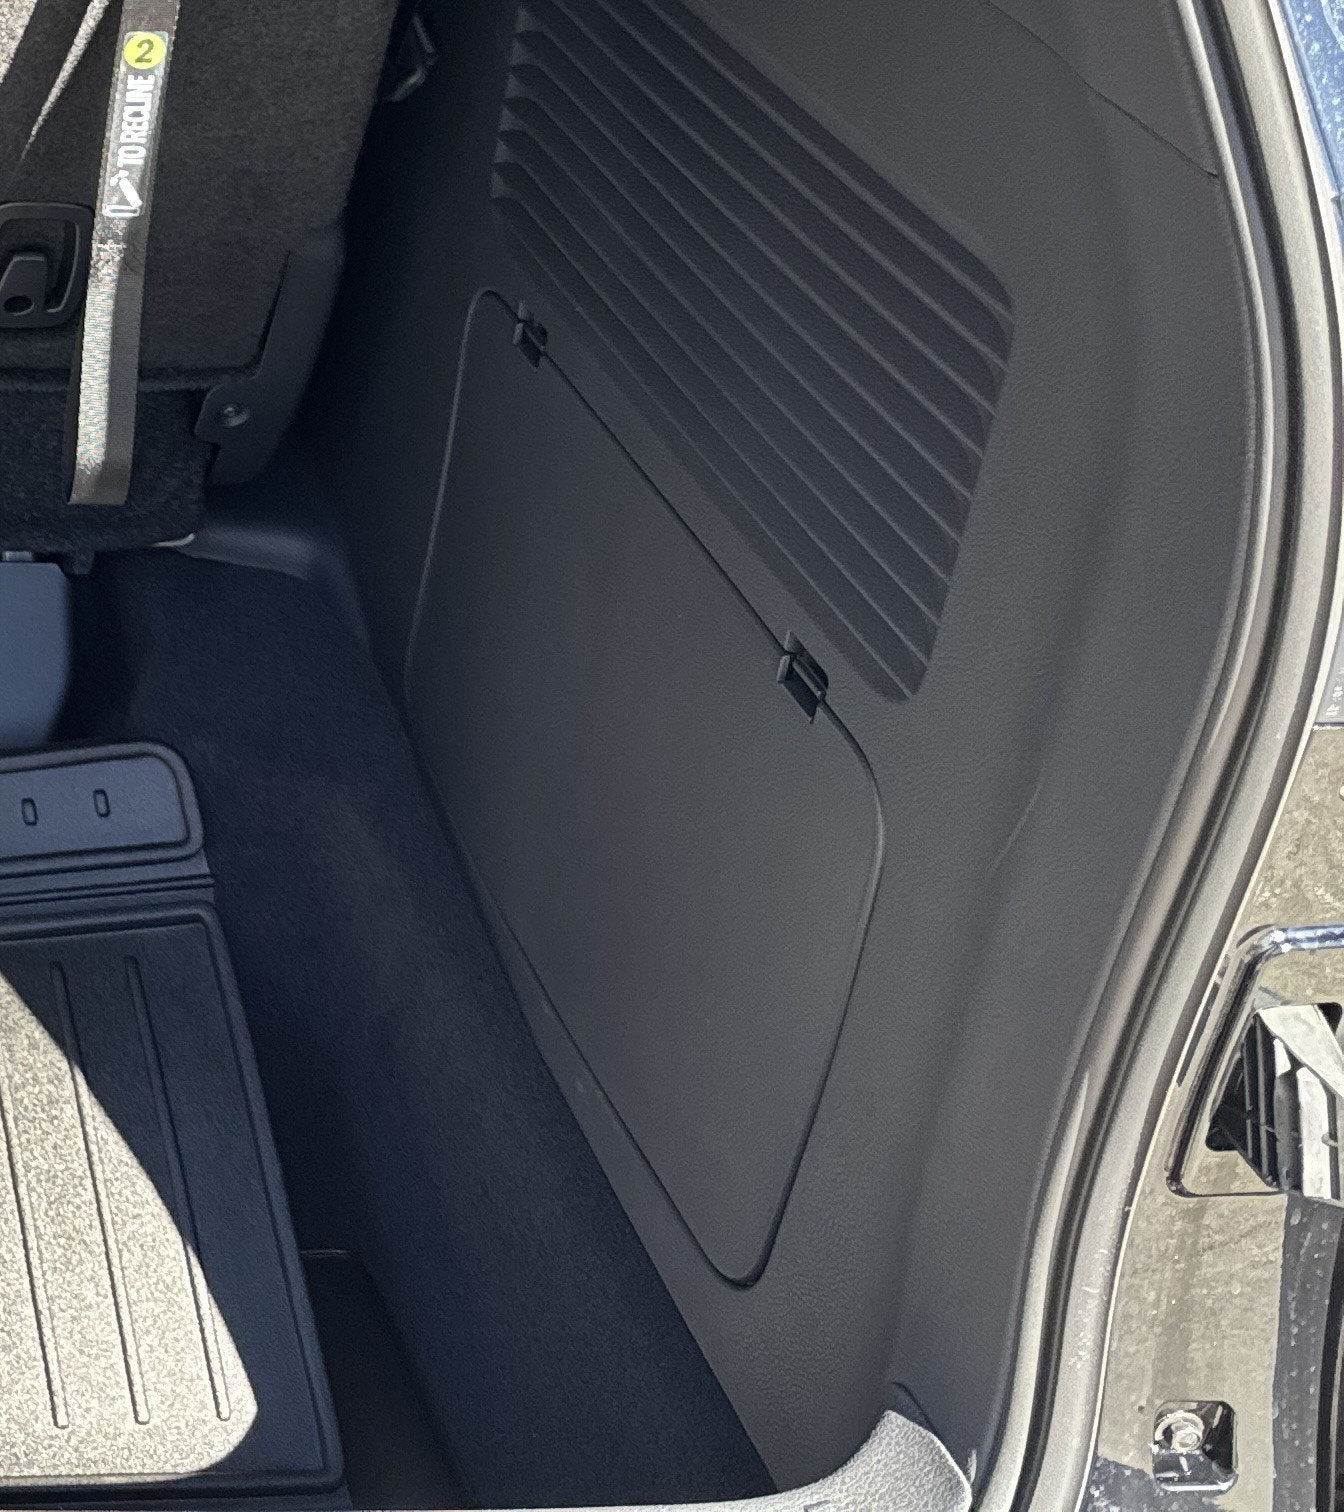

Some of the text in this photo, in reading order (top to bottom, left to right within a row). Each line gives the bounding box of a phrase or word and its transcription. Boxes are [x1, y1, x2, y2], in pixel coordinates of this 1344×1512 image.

[134, 38, 155, 64] 2
[117, 74, 155, 167] TO RECLINE
